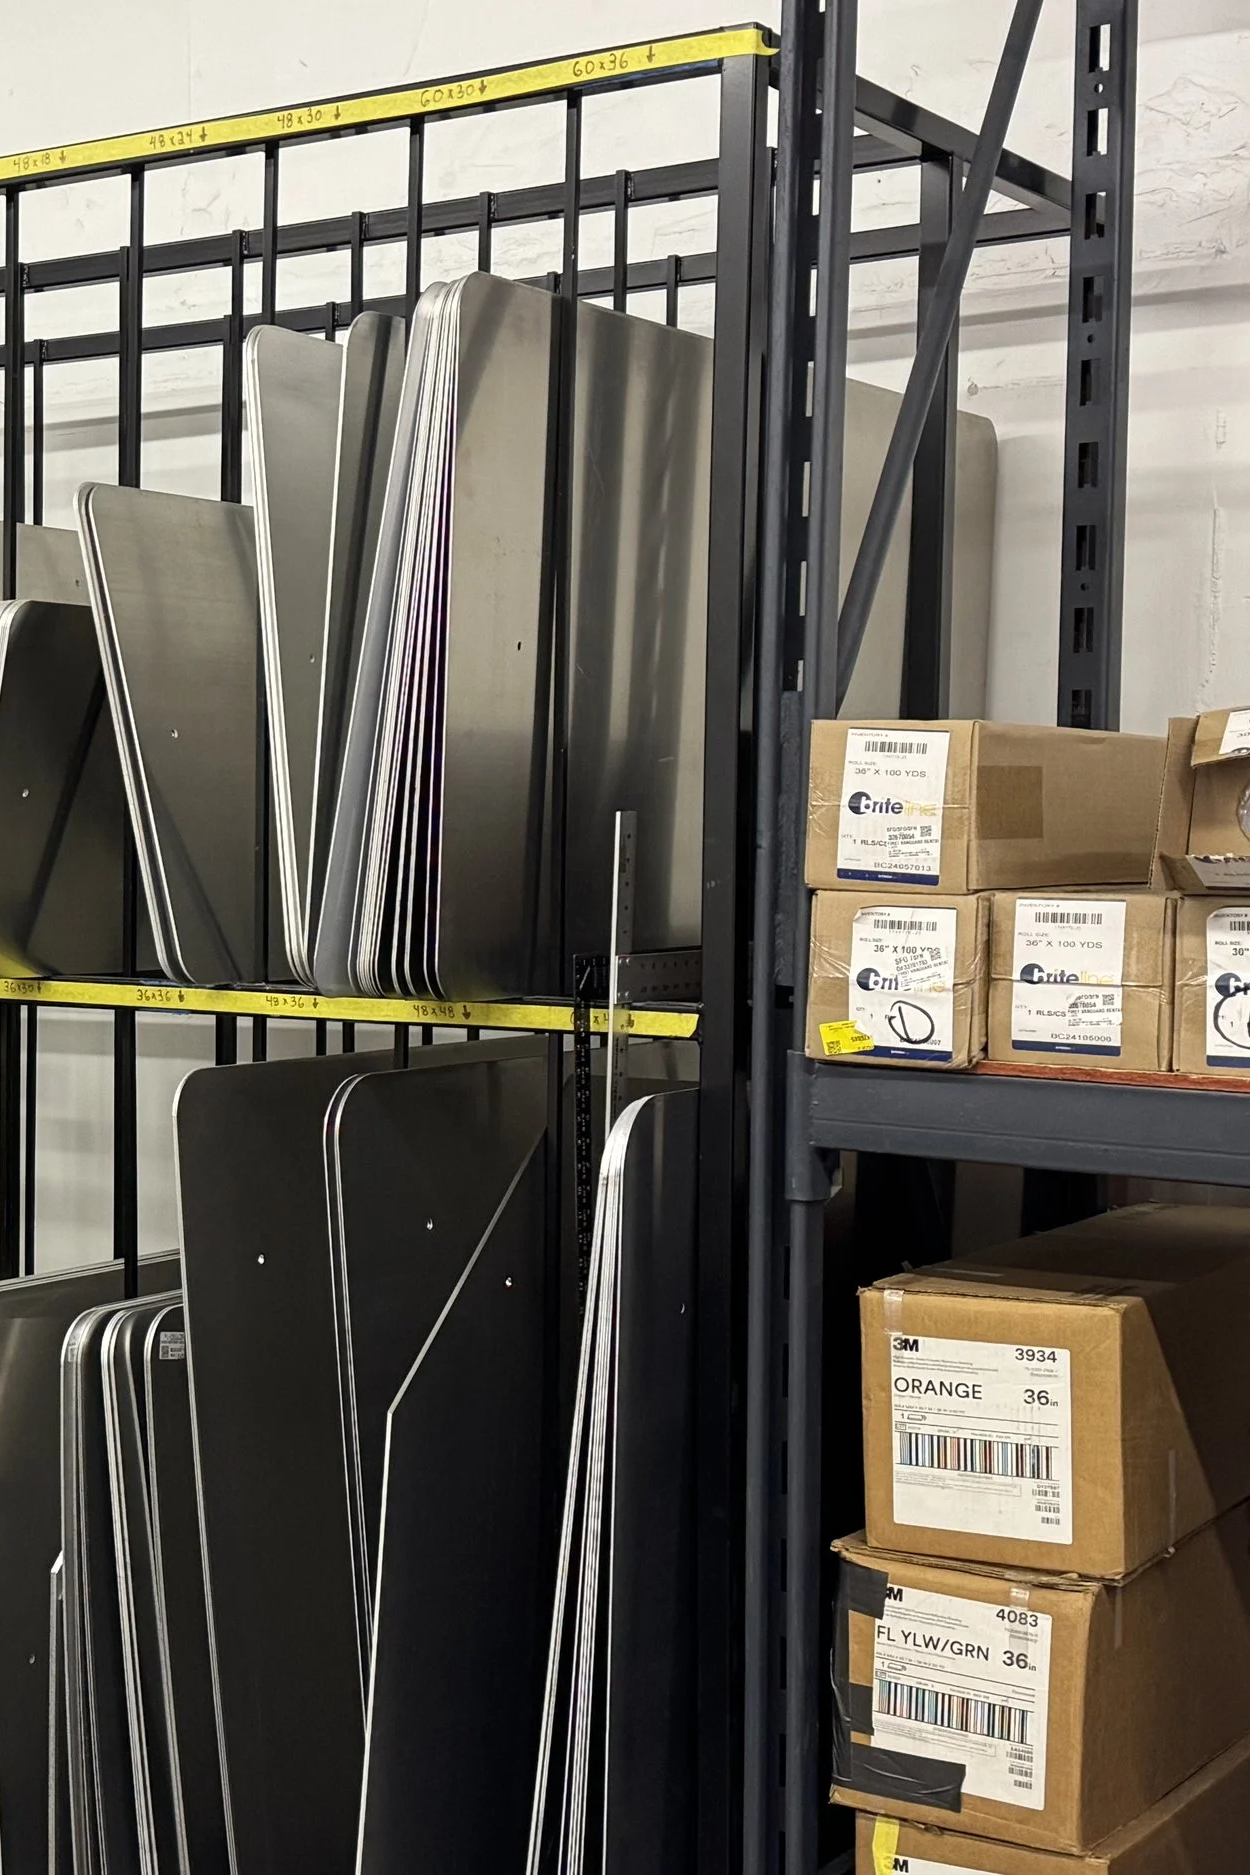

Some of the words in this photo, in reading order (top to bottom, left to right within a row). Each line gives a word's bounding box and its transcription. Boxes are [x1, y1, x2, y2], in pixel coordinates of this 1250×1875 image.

[573, 52, 629, 77] 60x36
[421, 84, 475, 108] 60x30
[277, 108, 323, 129] 48x30
[150, 129, 193, 149] 48x24
[13, 152, 51, 173] 48x18
[885, 769, 902, 777] 100
[873, 945, 890, 953] 36"
[892, 945, 899, 954] X
[901, 946, 917, 954] 100
[1046, 940, 1054, 948] X
[1079, 941, 1103, 949] YDS
[136, 988, 171, 1003] 36x36
[412, 1003, 455, 1019] 48x48
[893, 1337, 919, 1353] 3M
[1014, 1348, 1058, 1363] 3934
[894, 1377, 983, 1400] ORANGE
[885, 1587, 904, 1602] M
[996, 1608, 1039, 1628] 4083
[877, 1625, 896, 1642] FL
[901, 1630, 990, 1661] YLW/GRN
